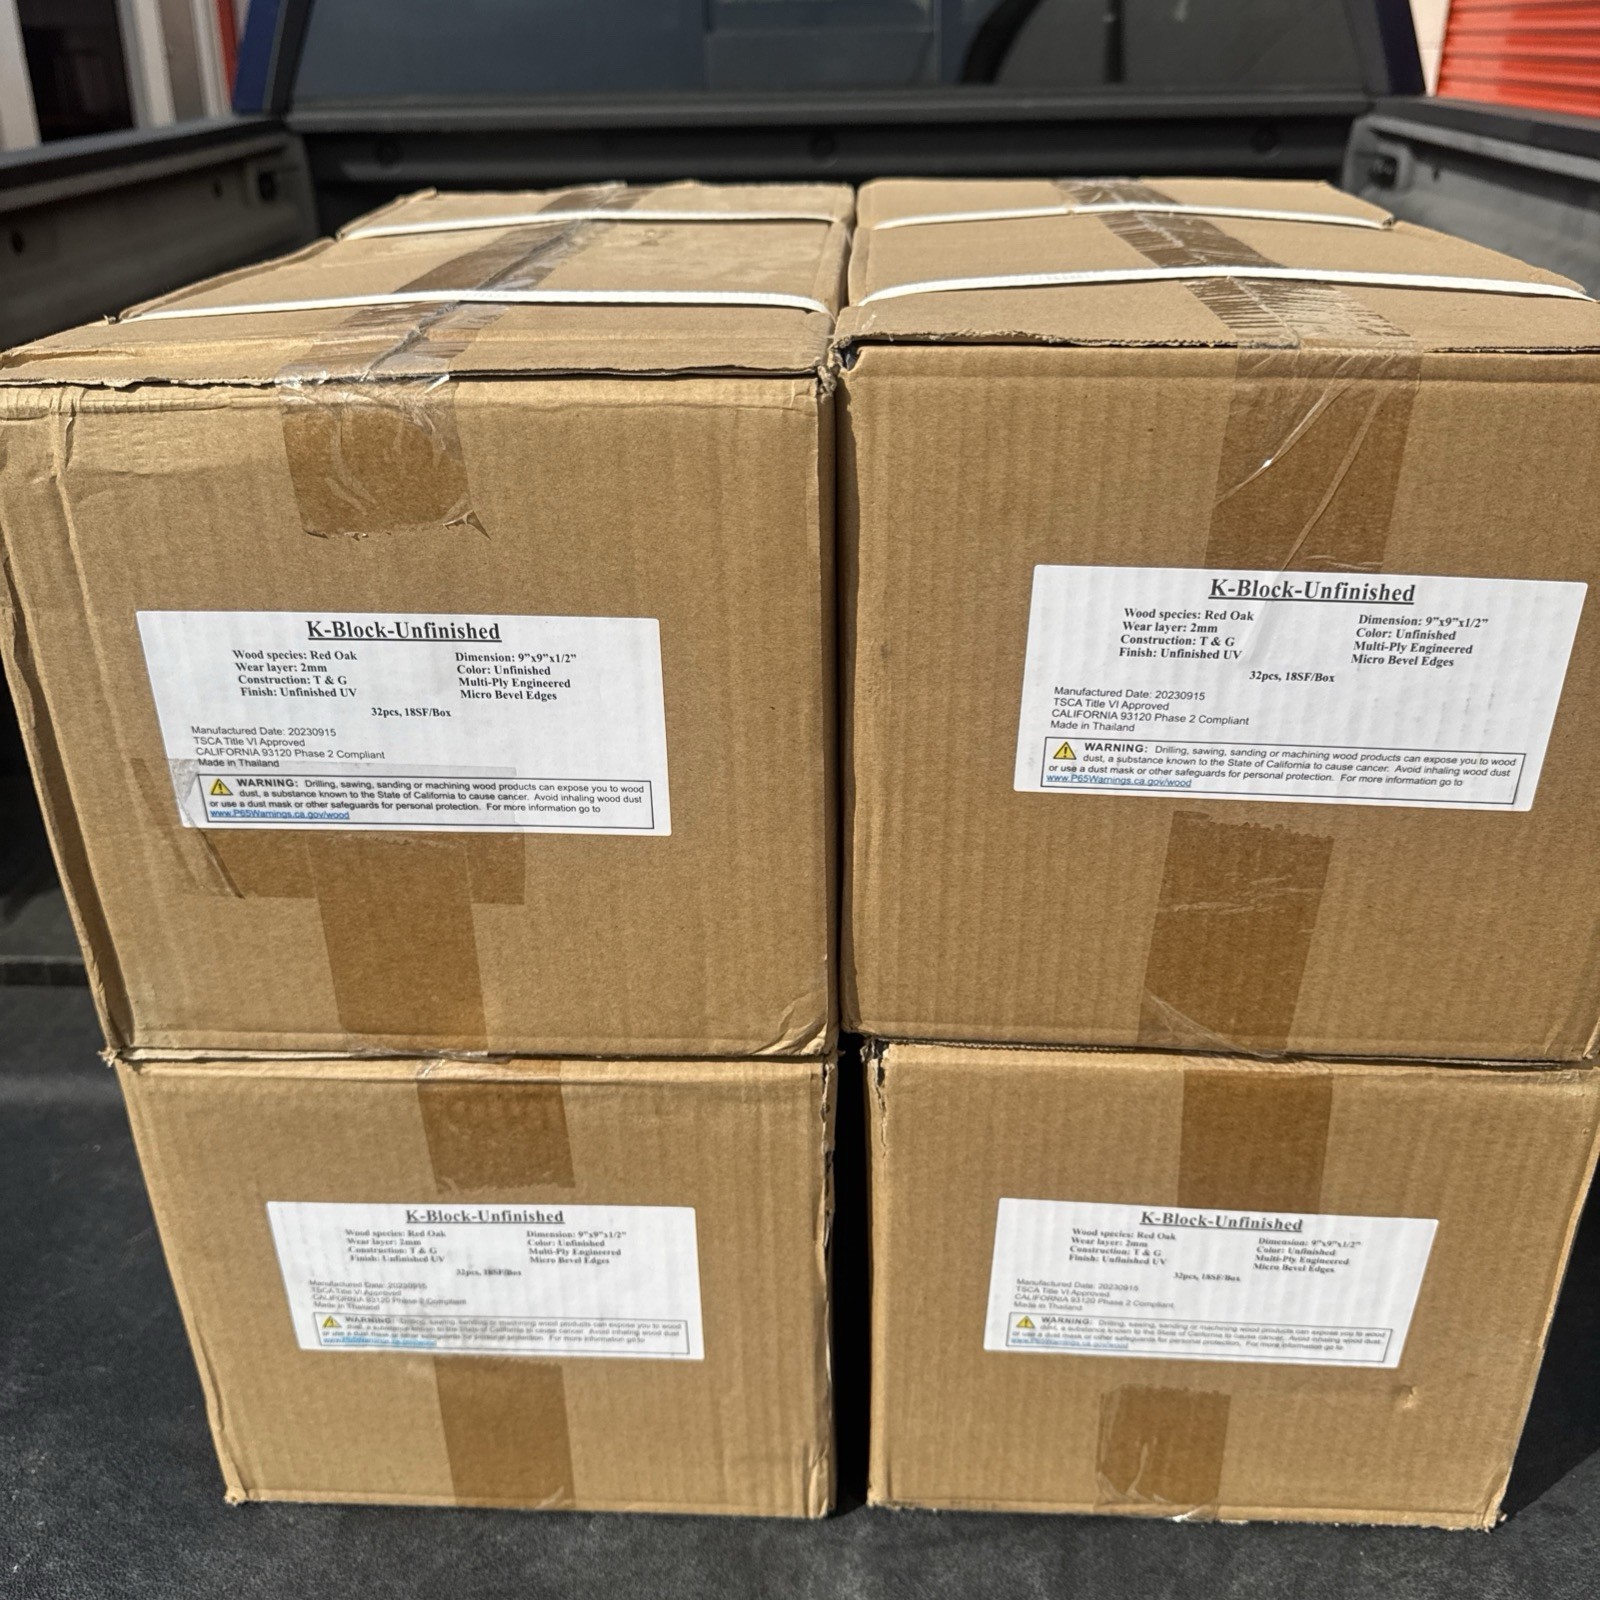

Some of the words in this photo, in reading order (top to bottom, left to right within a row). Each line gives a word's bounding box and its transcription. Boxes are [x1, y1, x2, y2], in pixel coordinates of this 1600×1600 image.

[1207, 578, 1416, 606] K-Block-Unfinished
[1123, 607, 1157, 619] Wood
[1158, 609, 1201, 621] species:
[1204, 609, 1228, 621] Red
[1229, 610, 1254, 622] Oak
[1358, 614, 1423, 627] Dimension:
[305, 620, 503, 643] K-Block-Unfinished
[1122, 620, 1153, 632] Wear
[1154, 619, 1187, 634] layer:
[1189, 622, 1219, 634] 2mm
[1119, 634, 1197, 646] Construction:
[1199, 635, 1209, 646] T
[1210, 636, 1221, 647] &
[1224, 636, 1236, 647] G
[1355, 627, 1393, 639] Color:
[1395, 628, 1457, 641] Unfinished
[1118, 646, 1157, 658] Finish:
[1160, 647, 1221, 660] Unfinished
[1223, 649, 1243, 660] UV
[1353, 640, 1408, 655] Multi-Ply
[1409, 642, 1474, 656] Engineered
[231, 649, 265, 660] Wood
[266, 649, 308, 662] species:
[309, 649, 332, 661] Red
[333, 650, 358, 661] Oak
[454, 651, 515, 663] Dimension:
[1350, 653, 1386, 665] Micro
[1387, 654, 1419, 666] Bevel
[1420, 655, 1455, 669] Edges
[234, 662, 265, 672] Wear
[265, 660, 298, 674] layer:
[300, 662, 328, 673] 2mm
[456, 664, 491, 675] Color:
[493, 665, 552, 676] Unfinished
[237, 674, 311, 685] Construction:
[312, 674, 322, 685] T
[324, 675, 335, 686] &
[336, 675, 348, 685] G
[458, 677, 509, 690] Multi-Ply
[511, 677, 571, 690] Engineered
[1249, 670, 1282, 683] 32pcs,
[1285, 671, 1335, 683] 18SF/Box
[240, 686, 278, 697] Finish:
[279, 687, 338, 698] Unfinished
[339, 687, 357, 698] UV
[460, 689, 493, 700] Micro
[494, 689, 524, 700] Bevel
[525, 690, 558, 703] Edges
[1053, 686, 1123, 698] Manufactured
[1124, 688, 1152, 699] Date:
[1154, 689, 1206, 701] 20230915
[1053, 697, 1084, 708] TSCA
[1084, 698, 1106, 709] Title
[1108, 699, 1120, 709] VI
[1120, 700, 1170, 711] Approved
[371, 706, 403, 719] 32pcs,
[404, 707, 452, 717] 18SF/Box
[1051, 708, 1119, 720] CALIFORNIA
[1120, 711, 1153, 722] 93120
[1153, 712, 1187, 723] Phase
[1188, 713, 1197, 724] 2
[1197, 714, 1250, 726] Compliant
[190, 725, 258, 736] Manufactured
[258, 726, 286, 736] Date:
[287, 726, 337, 737] 20230915
[1050, 719, 1079, 730] Made
[1080, 721, 1091, 730] in
[1092, 721, 1136, 732] Thailand
[192, 736, 224, 746] TSCA
[222, 736, 245, 746] Title
[245, 737, 258, 746] VI
[258, 737, 306, 748] Approved
[194, 746, 261, 757] CALIFORNIA
[260, 747, 293, 758] 93120
[293, 748, 326, 759] Phase
[326, 749, 334, 759] 2
[335, 749, 386, 760] Compliant
[1084, 742, 1148, 754] WARNING:
[1154, 745, 1190, 756] Drilling,
[1192, 747, 1227, 758] sawing,
[1229, 748, 1268, 759] sanding
[1268, 750, 1281, 758] or
[1281, 750, 1331, 762] machining
[1332, 752, 1359, 761] wood
[1359, 753, 1402, 763] products
[1403, 755, 1422, 763] can
[1422, 756, 1459, 765] expose
[1459, 758, 1478, 767] you
[1478, 757, 1489, 766] to
[1490, 758, 1518, 767] wood
[197, 758, 225, 767] Made
[238, 758, 280, 768] Thailand
[235, 778, 299, 788] WARNING:
[304, 779, 339, 790] Drilling,
[339, 780, 375, 790] sawing,
[376, 780, 412, 791] sanding
[412, 782, 423, 790] or
[424, 781, 471, 792] machining
[471, 782, 497, 791] wood
[498, 782, 537, 792] products
[538, 784, 556, 792] can
[556, 784, 590, 793] expose
[590, 785, 608, 794] you
[609, 785, 619, 793] to
[620, 785, 645, 794] wood
[1046, 772, 1193, 789] www.P65Warnings.ca.gov/wood
[209, 808, 351, 821] www.P65Warnings.ca.gov/wood
[405, 1209, 566, 1225] K-Block-Unfinished
[1139, 1211, 1304, 1234] K-Block-Unfinished
